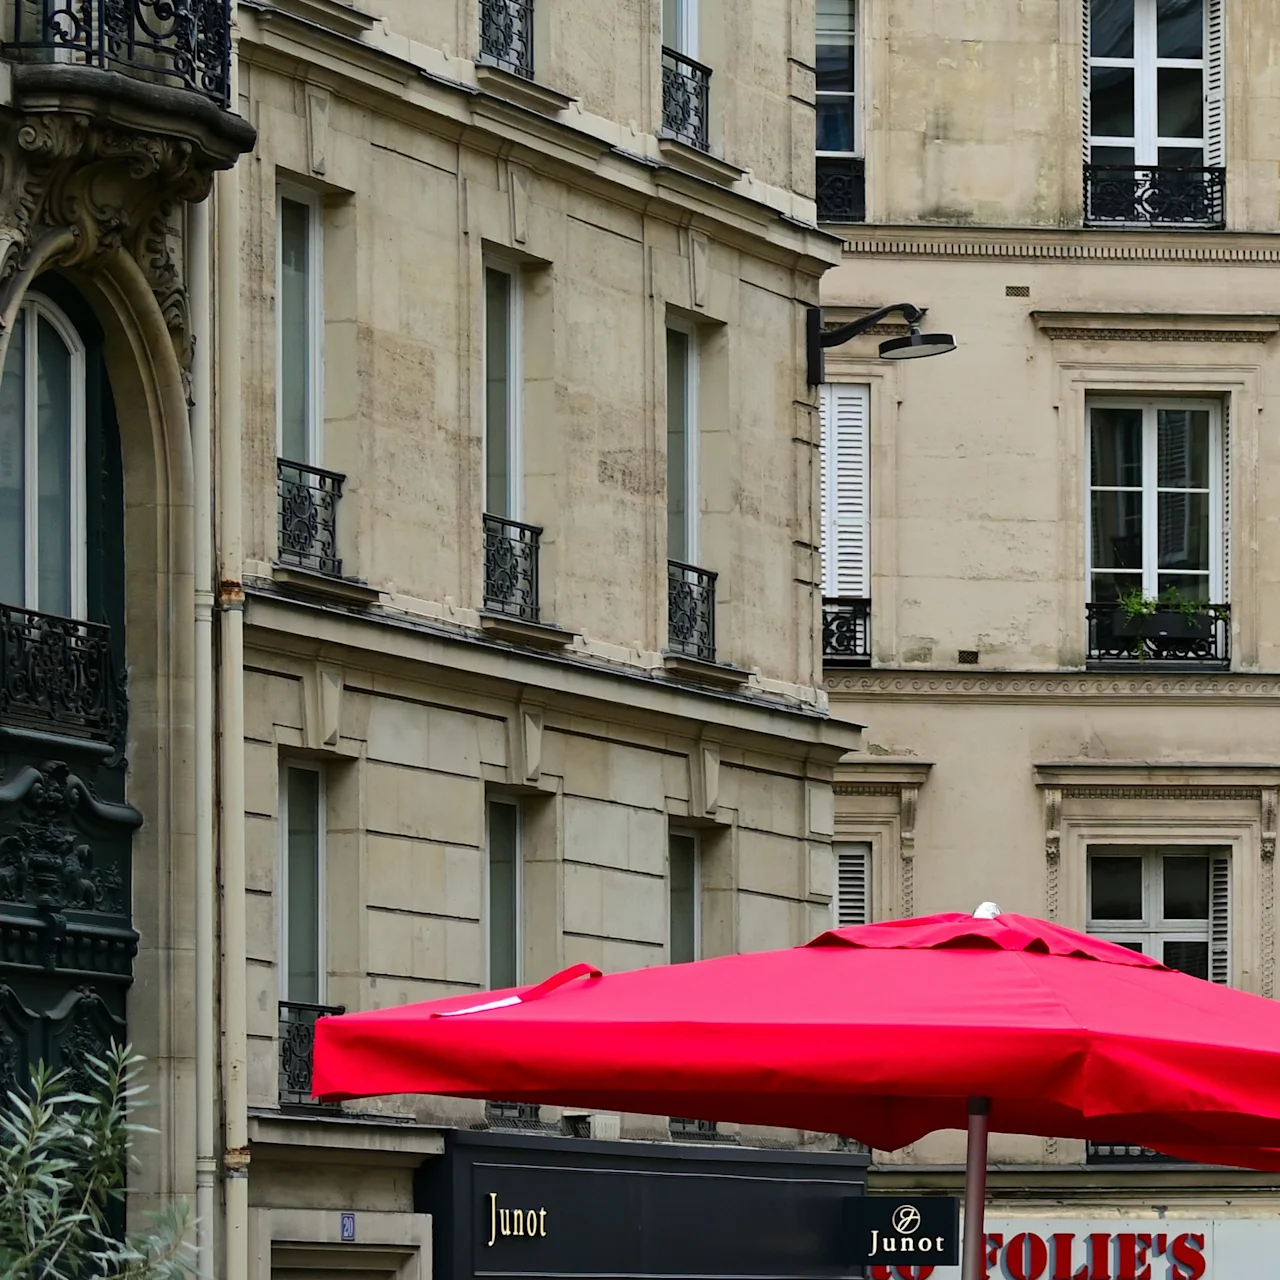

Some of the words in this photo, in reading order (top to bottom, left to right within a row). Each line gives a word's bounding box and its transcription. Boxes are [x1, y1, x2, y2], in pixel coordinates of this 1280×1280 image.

[342, 1216, 354, 1239] 20
[488, 1192, 547, 1247] Junot
[868, 1230, 944, 1256] Junot
